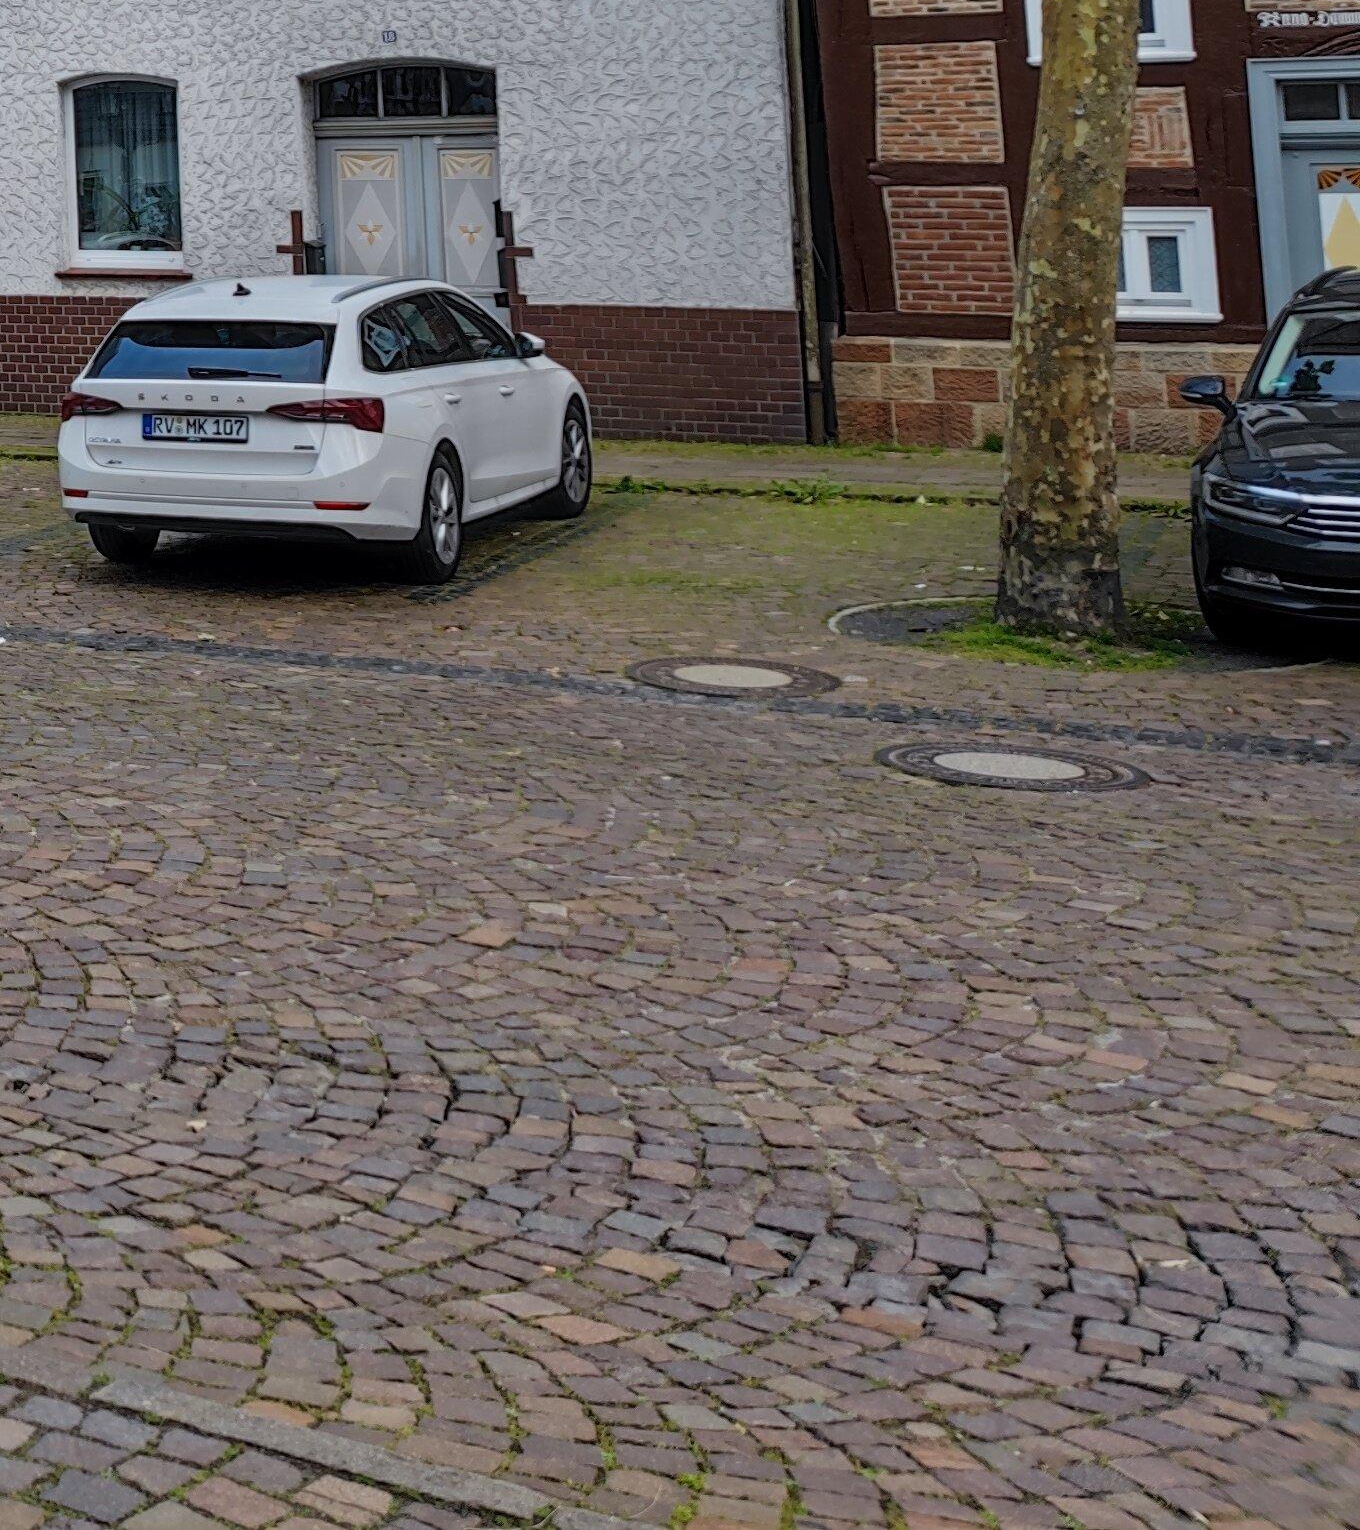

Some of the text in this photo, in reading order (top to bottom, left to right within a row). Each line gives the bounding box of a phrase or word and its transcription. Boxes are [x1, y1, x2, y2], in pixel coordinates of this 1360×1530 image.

[153, 418, 245, 437] RV MK 107
